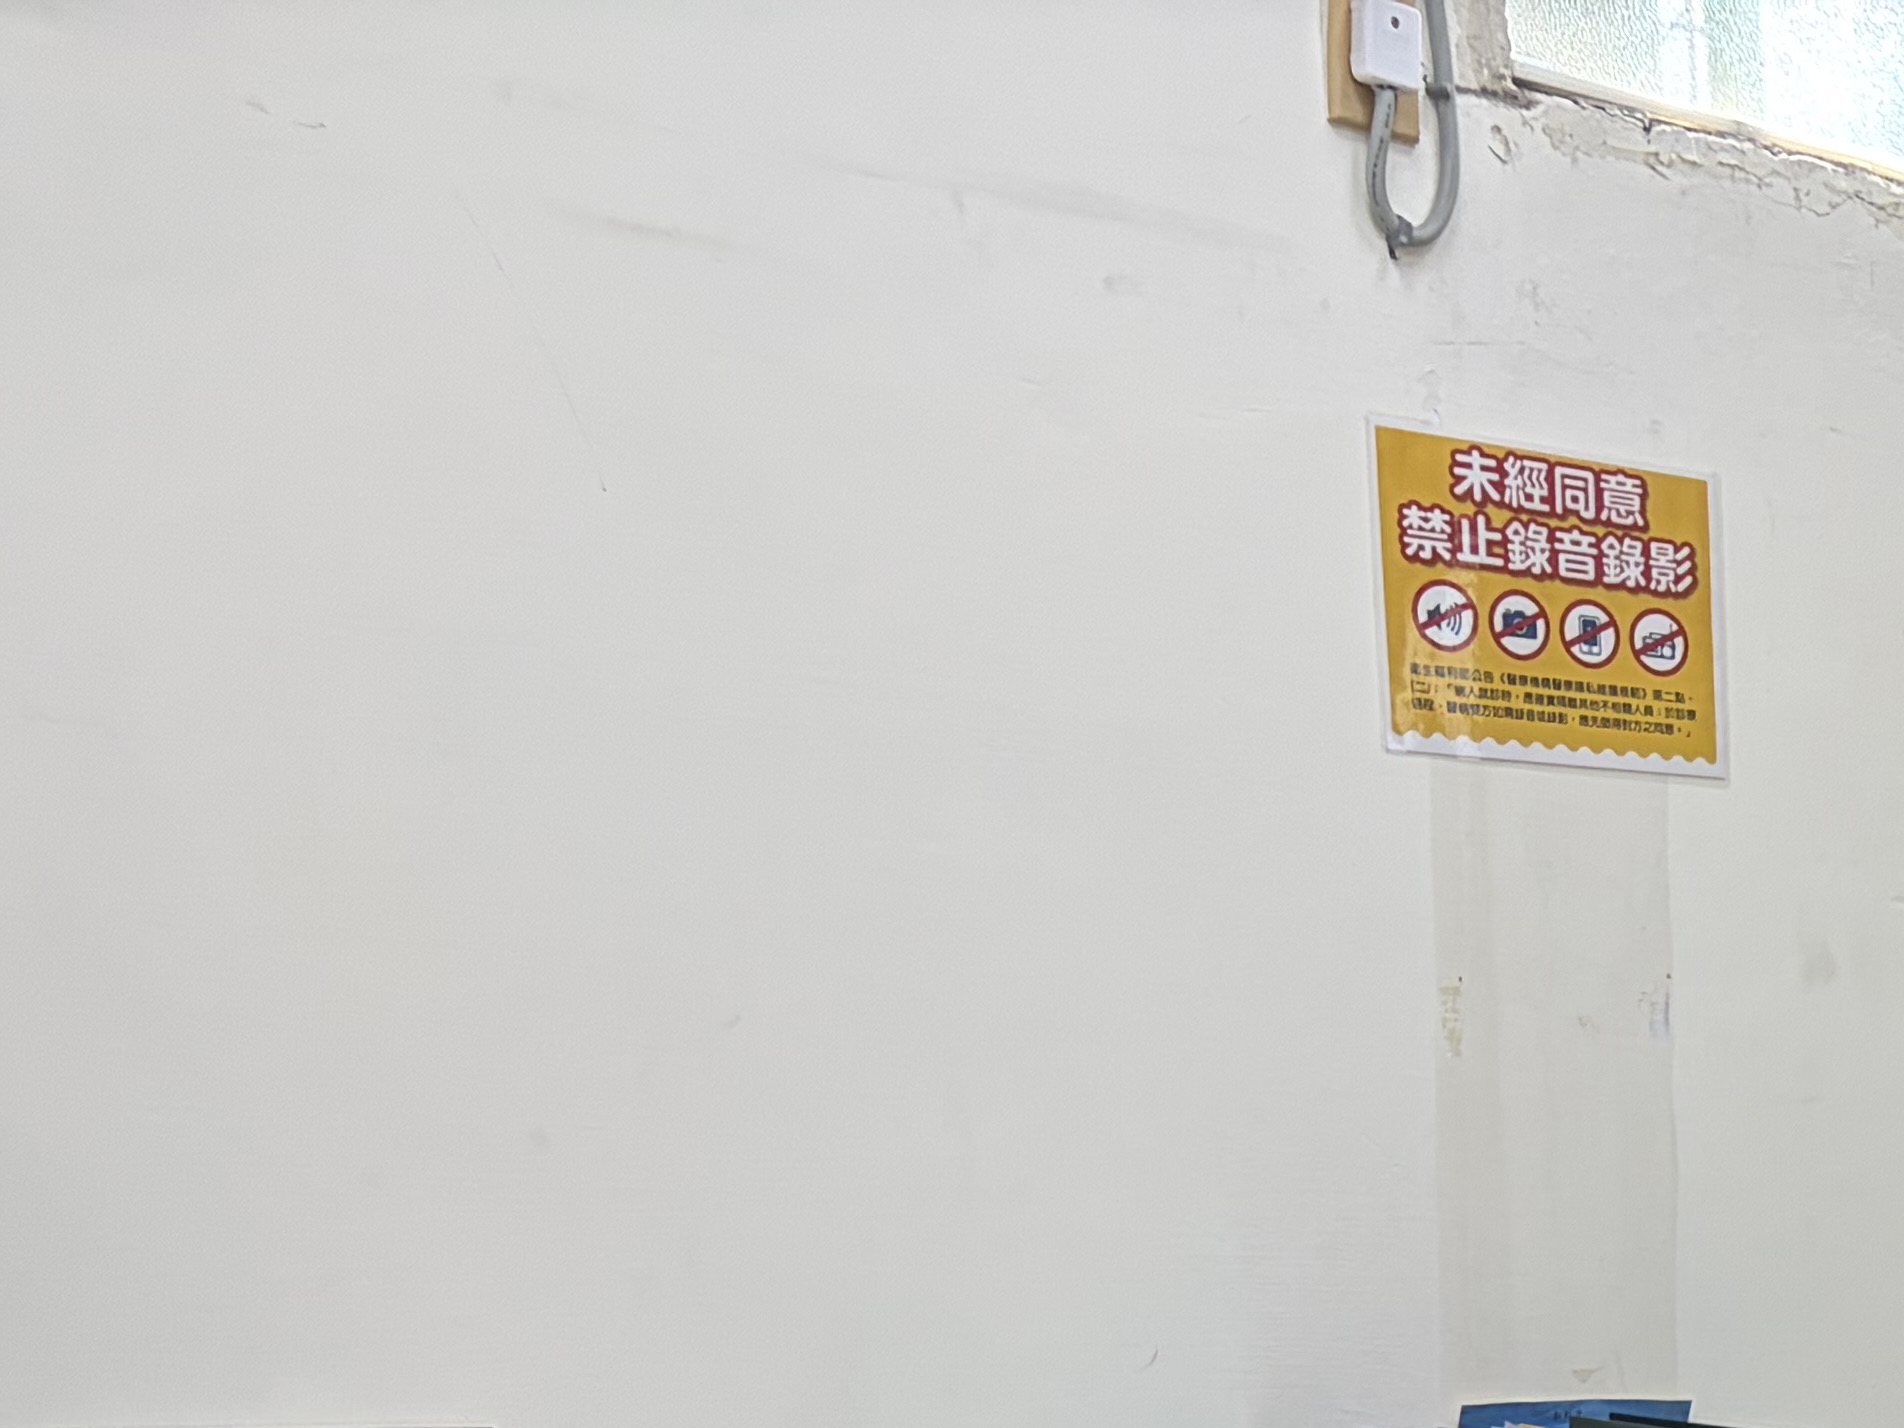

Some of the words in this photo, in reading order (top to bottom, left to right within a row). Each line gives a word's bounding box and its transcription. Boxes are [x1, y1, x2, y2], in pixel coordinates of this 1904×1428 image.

[1452, 449, 1645, 528] 未經同意
[1401, 504, 1694, 593] 禁止錄音錄影
